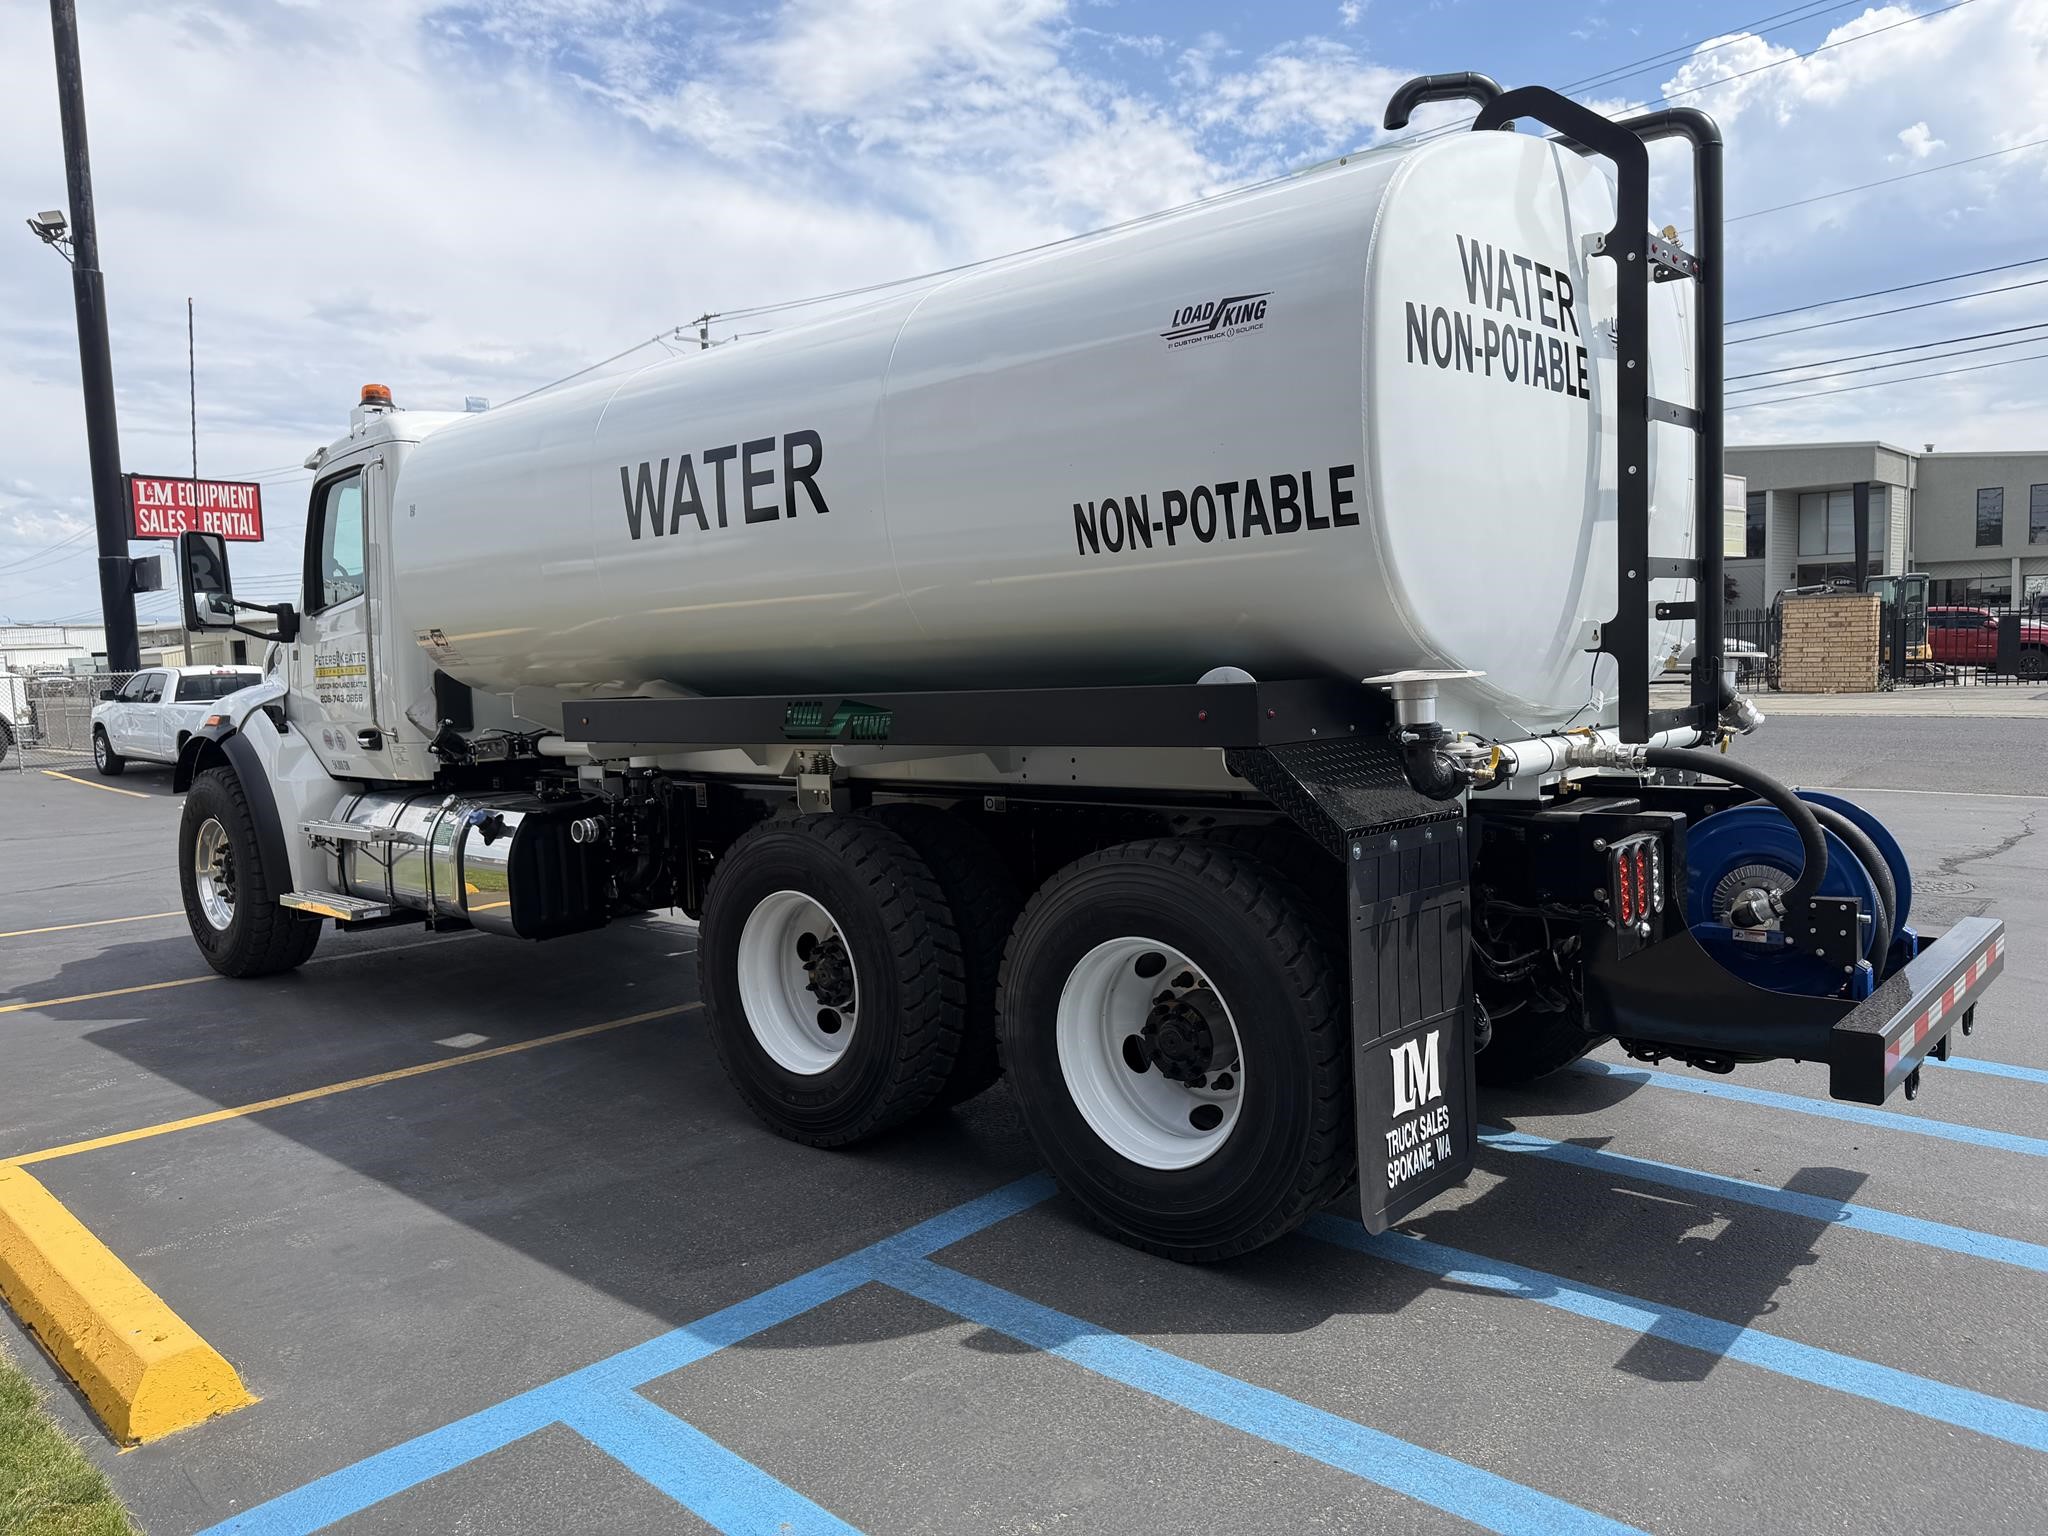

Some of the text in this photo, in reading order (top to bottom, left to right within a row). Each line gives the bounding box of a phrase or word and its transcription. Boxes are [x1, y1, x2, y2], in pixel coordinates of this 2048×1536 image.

[1456, 234, 1579, 337] WATER
[1172, 299, 1267, 328] LOAD KING
[1174, 337, 1201, 348] CUSTOM
[1203, 331, 1226, 342] TRUCK
[1236, 323, 1264, 334] SOURCE
[1406, 302, 1590, 400] NON-POTABLE
[136, 481, 255, 509] L&M EQUIPMENT
[620, 429, 829, 540] WATER
[1073, 464, 1360, 556] NON-POTABLE
[139, 508, 257, 535] SALES RENTAL
[1386, 1104, 1449, 1158] TRUCK SALES
[1388, 1134, 1451, 1189] SPOKANE, WA
